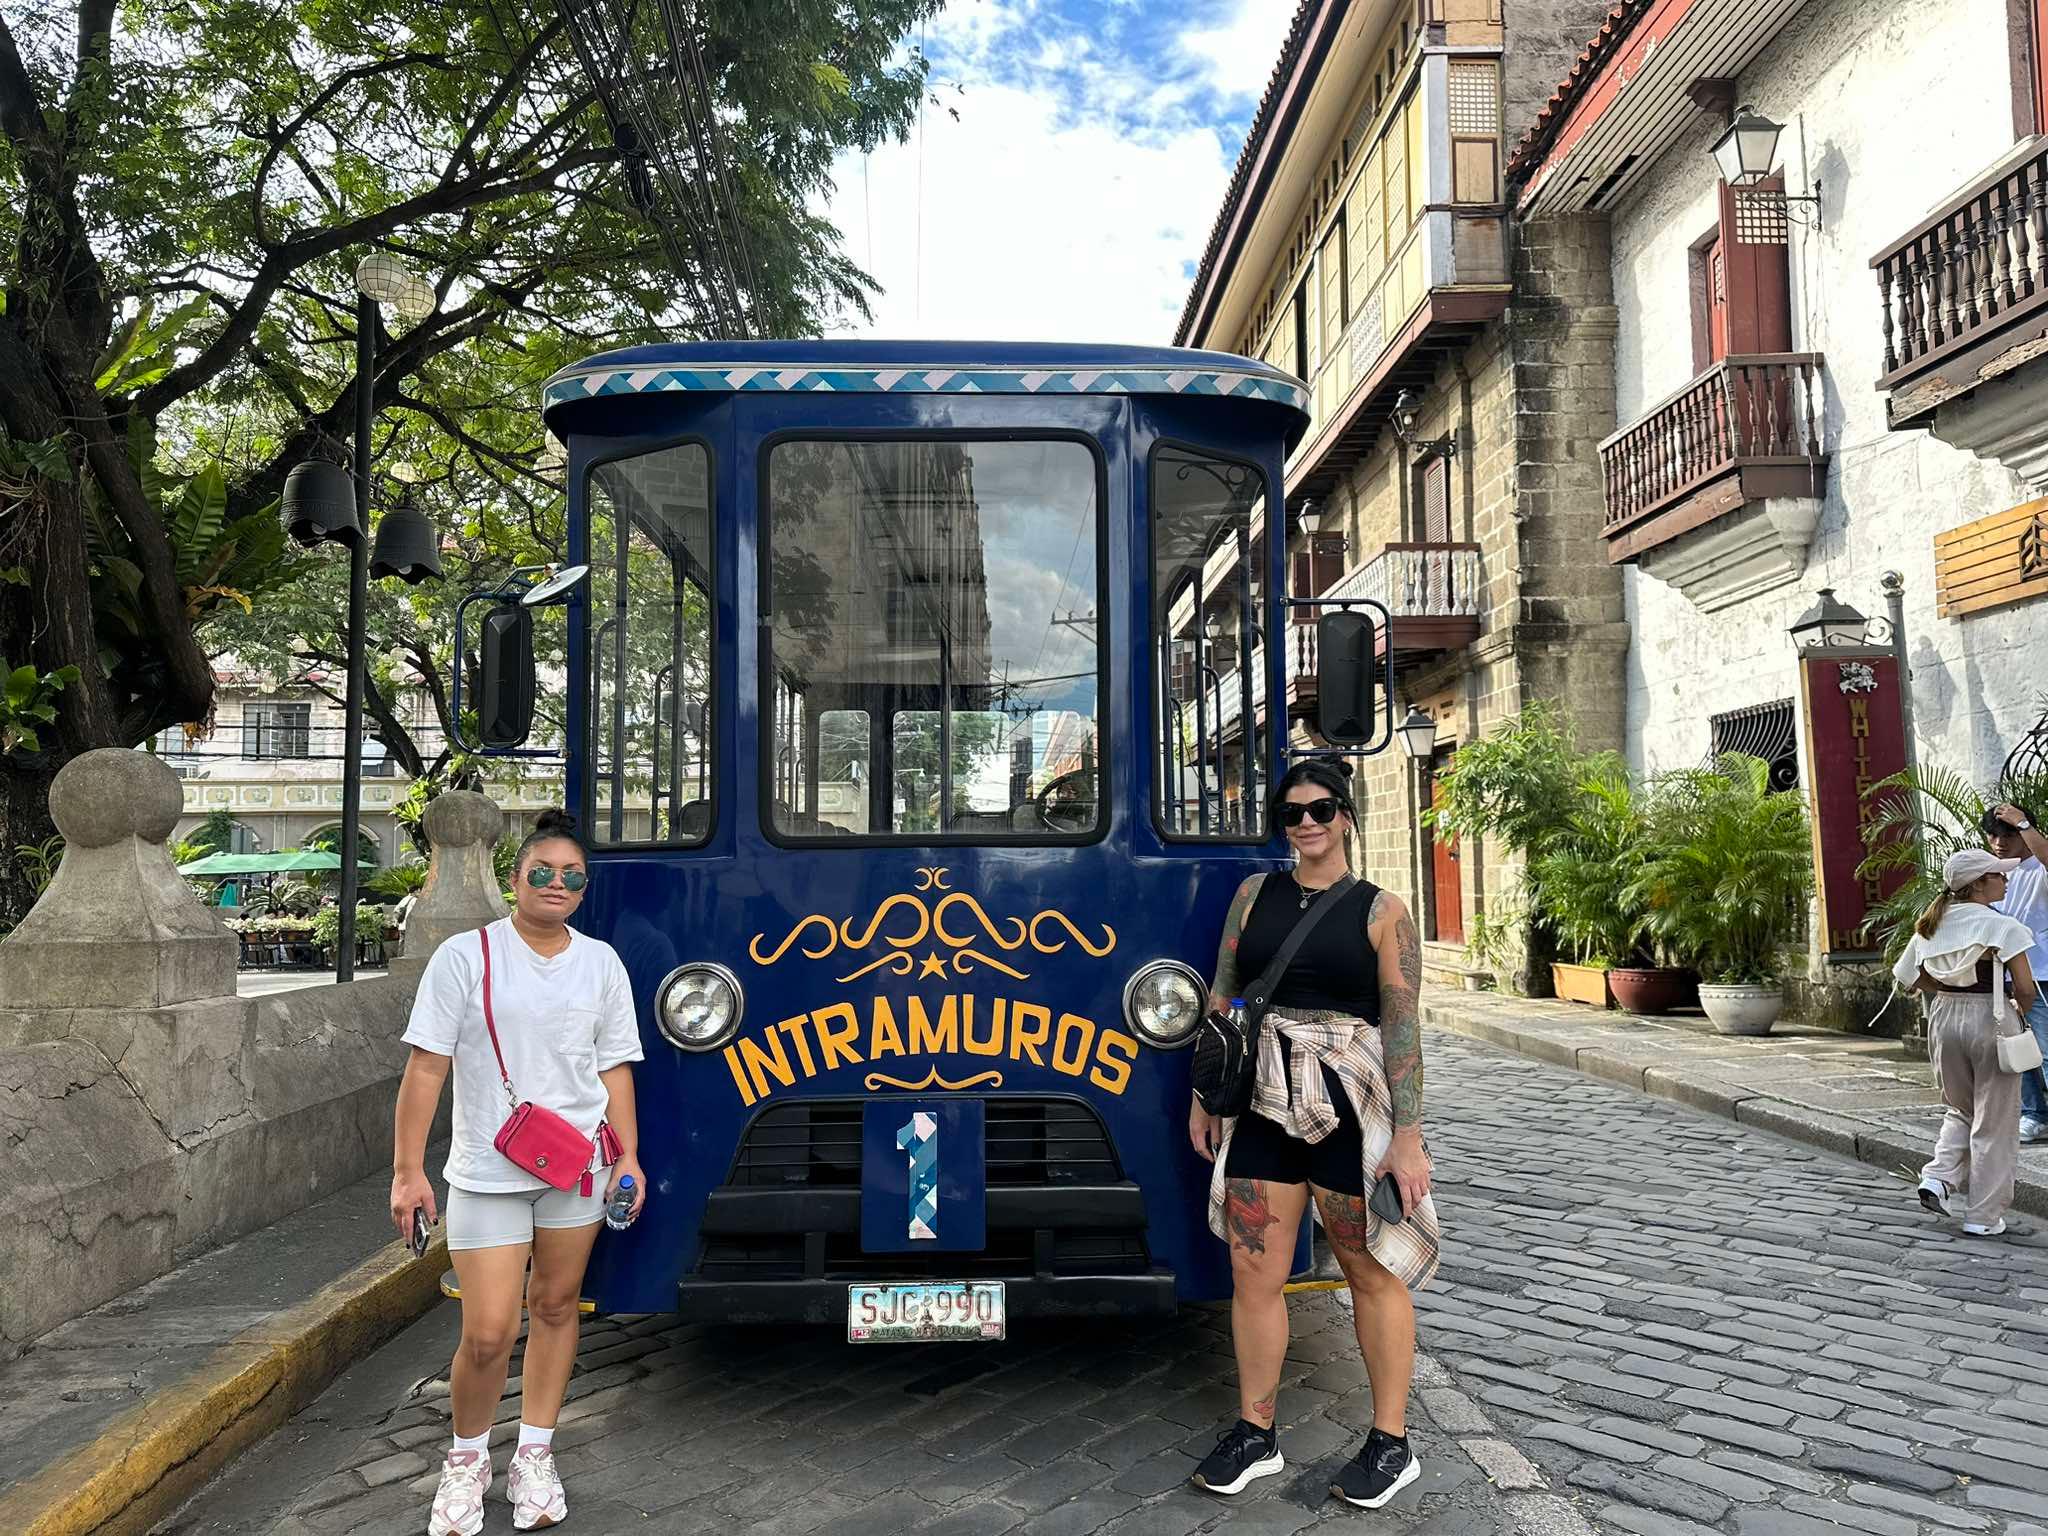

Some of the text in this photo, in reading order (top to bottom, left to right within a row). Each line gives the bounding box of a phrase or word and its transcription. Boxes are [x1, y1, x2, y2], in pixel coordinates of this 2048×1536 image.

[1848, 698, 1873, 796] WHITE
[724, 994, 1138, 1106] INTRAMUROS
[896, 1111, 938, 1240] 1
[861, 1290, 993, 1325] SJC 990
